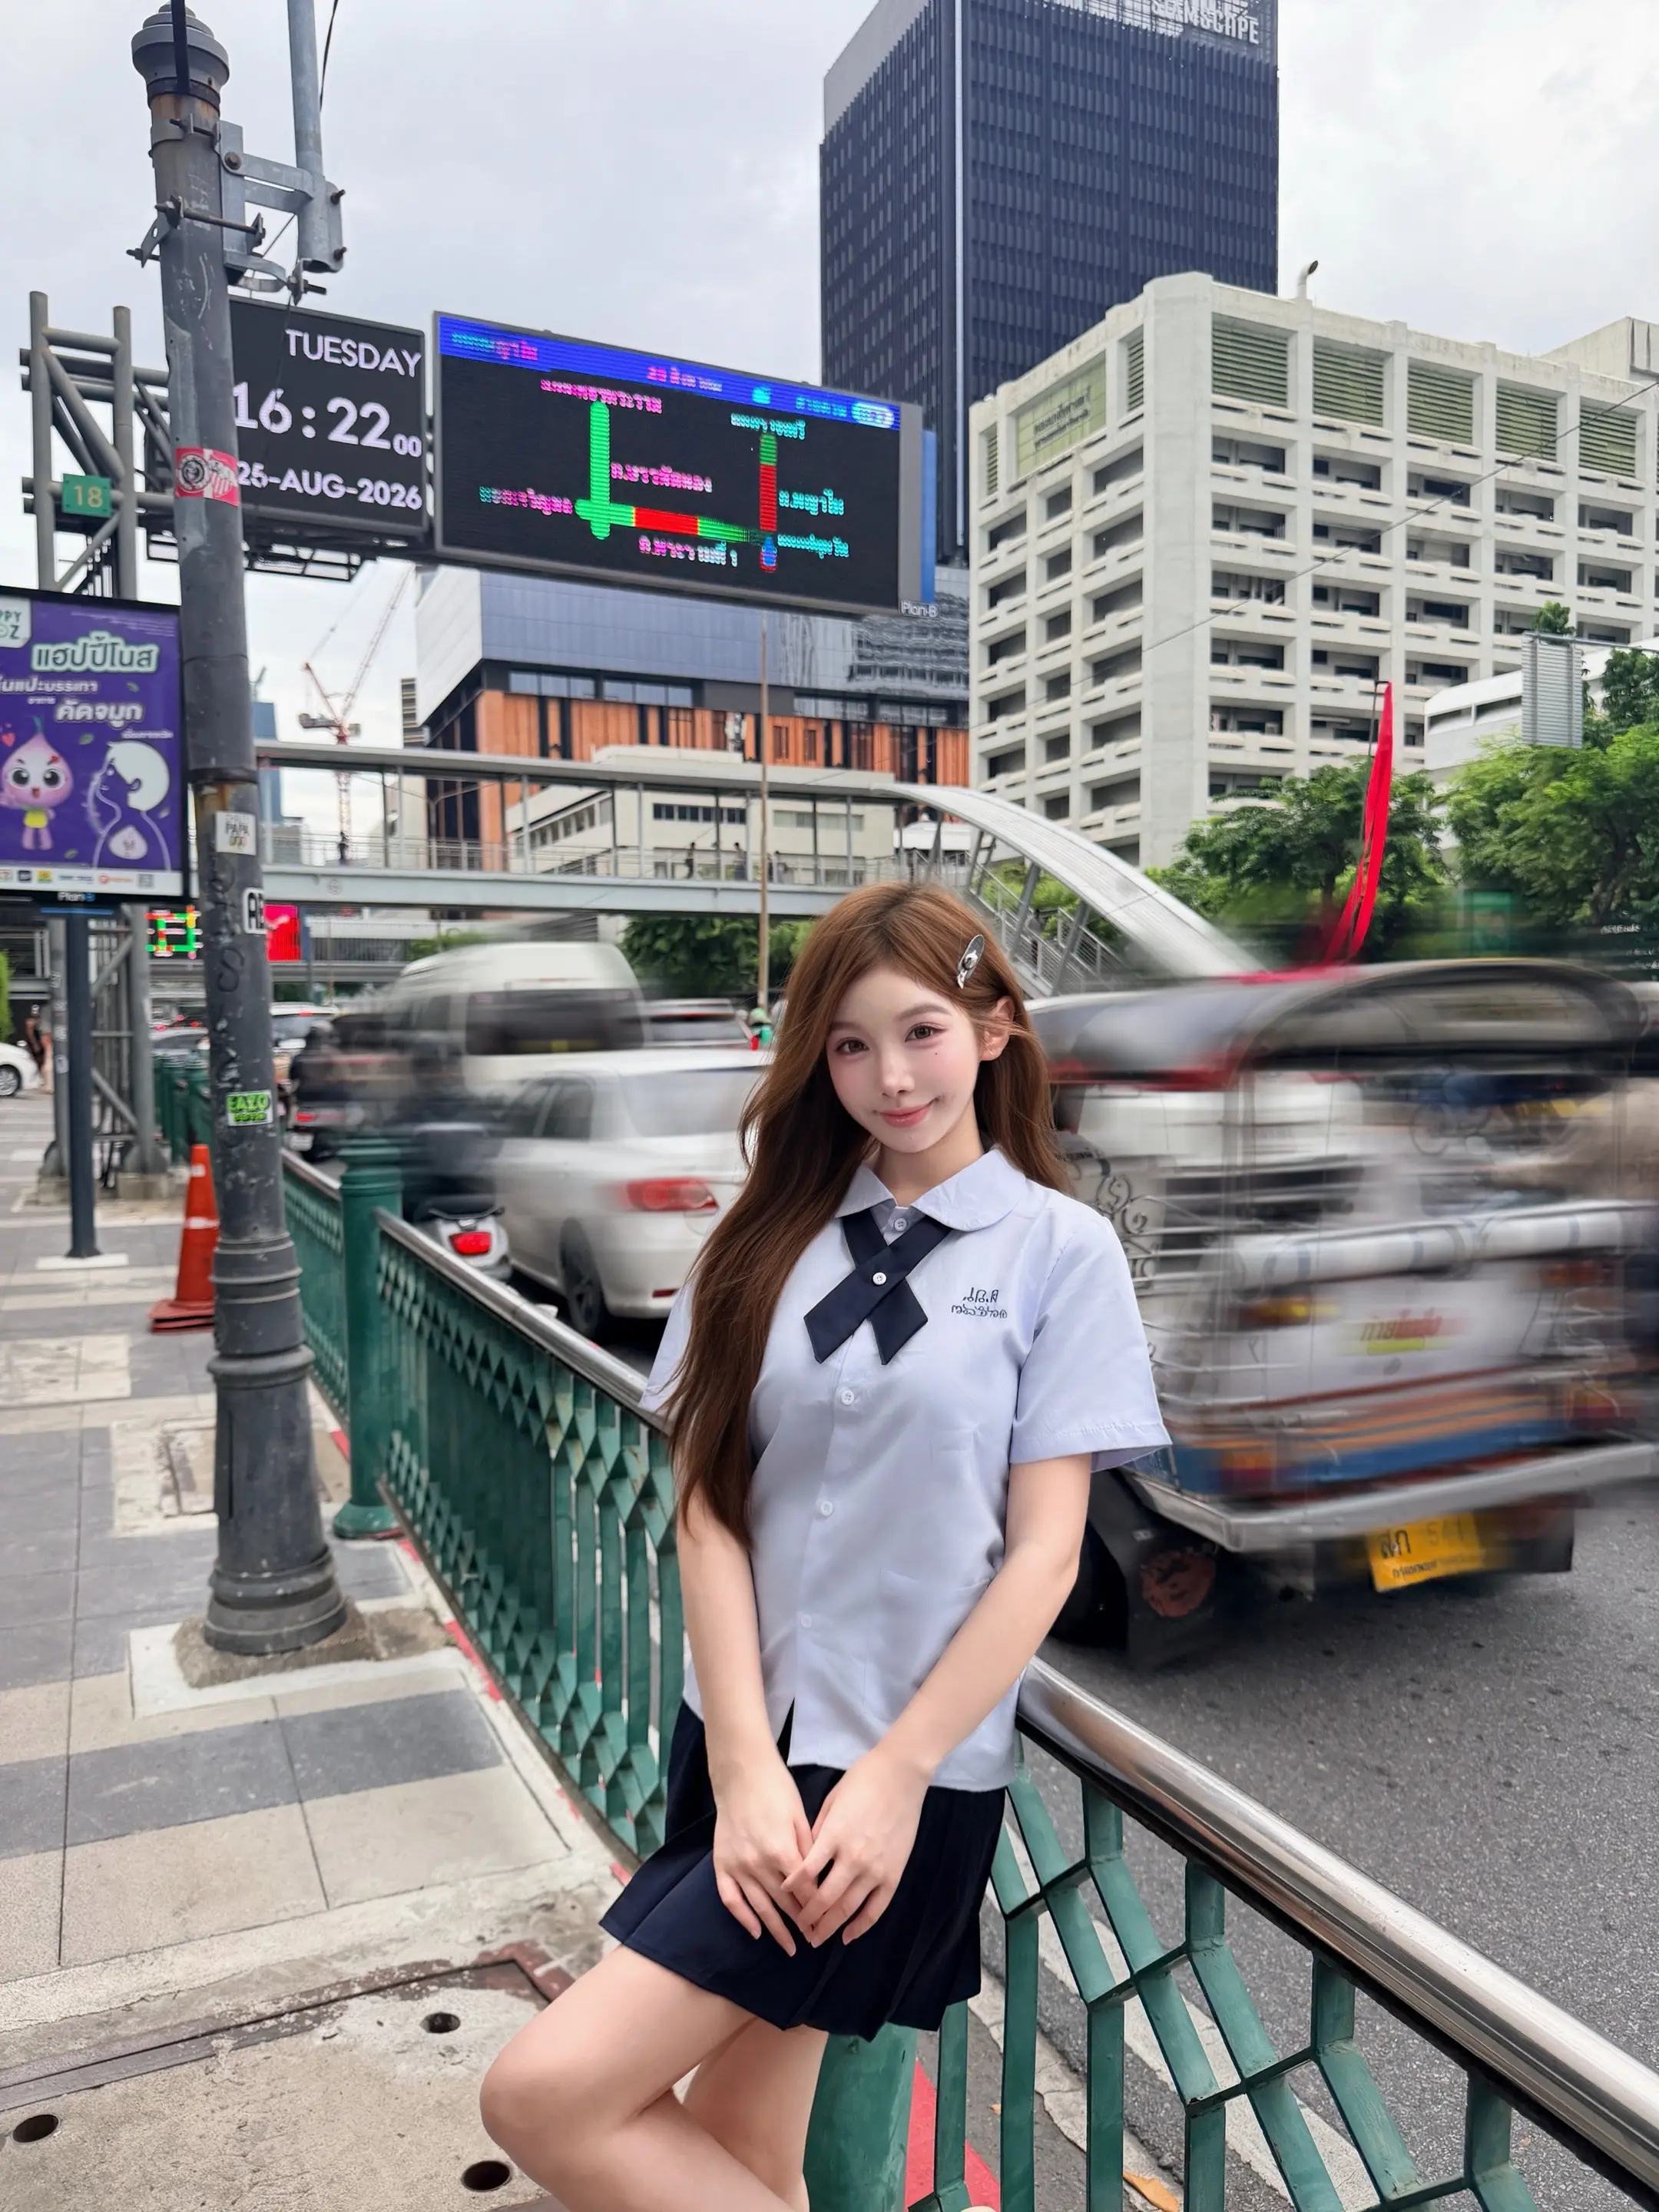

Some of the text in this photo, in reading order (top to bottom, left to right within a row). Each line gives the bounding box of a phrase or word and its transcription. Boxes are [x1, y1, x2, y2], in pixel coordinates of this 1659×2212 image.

[285, 329, 422, 377] TUESDAY
[74, 485, 103, 508] 18
[237, 460, 422, 510] 25-AUG-2026
